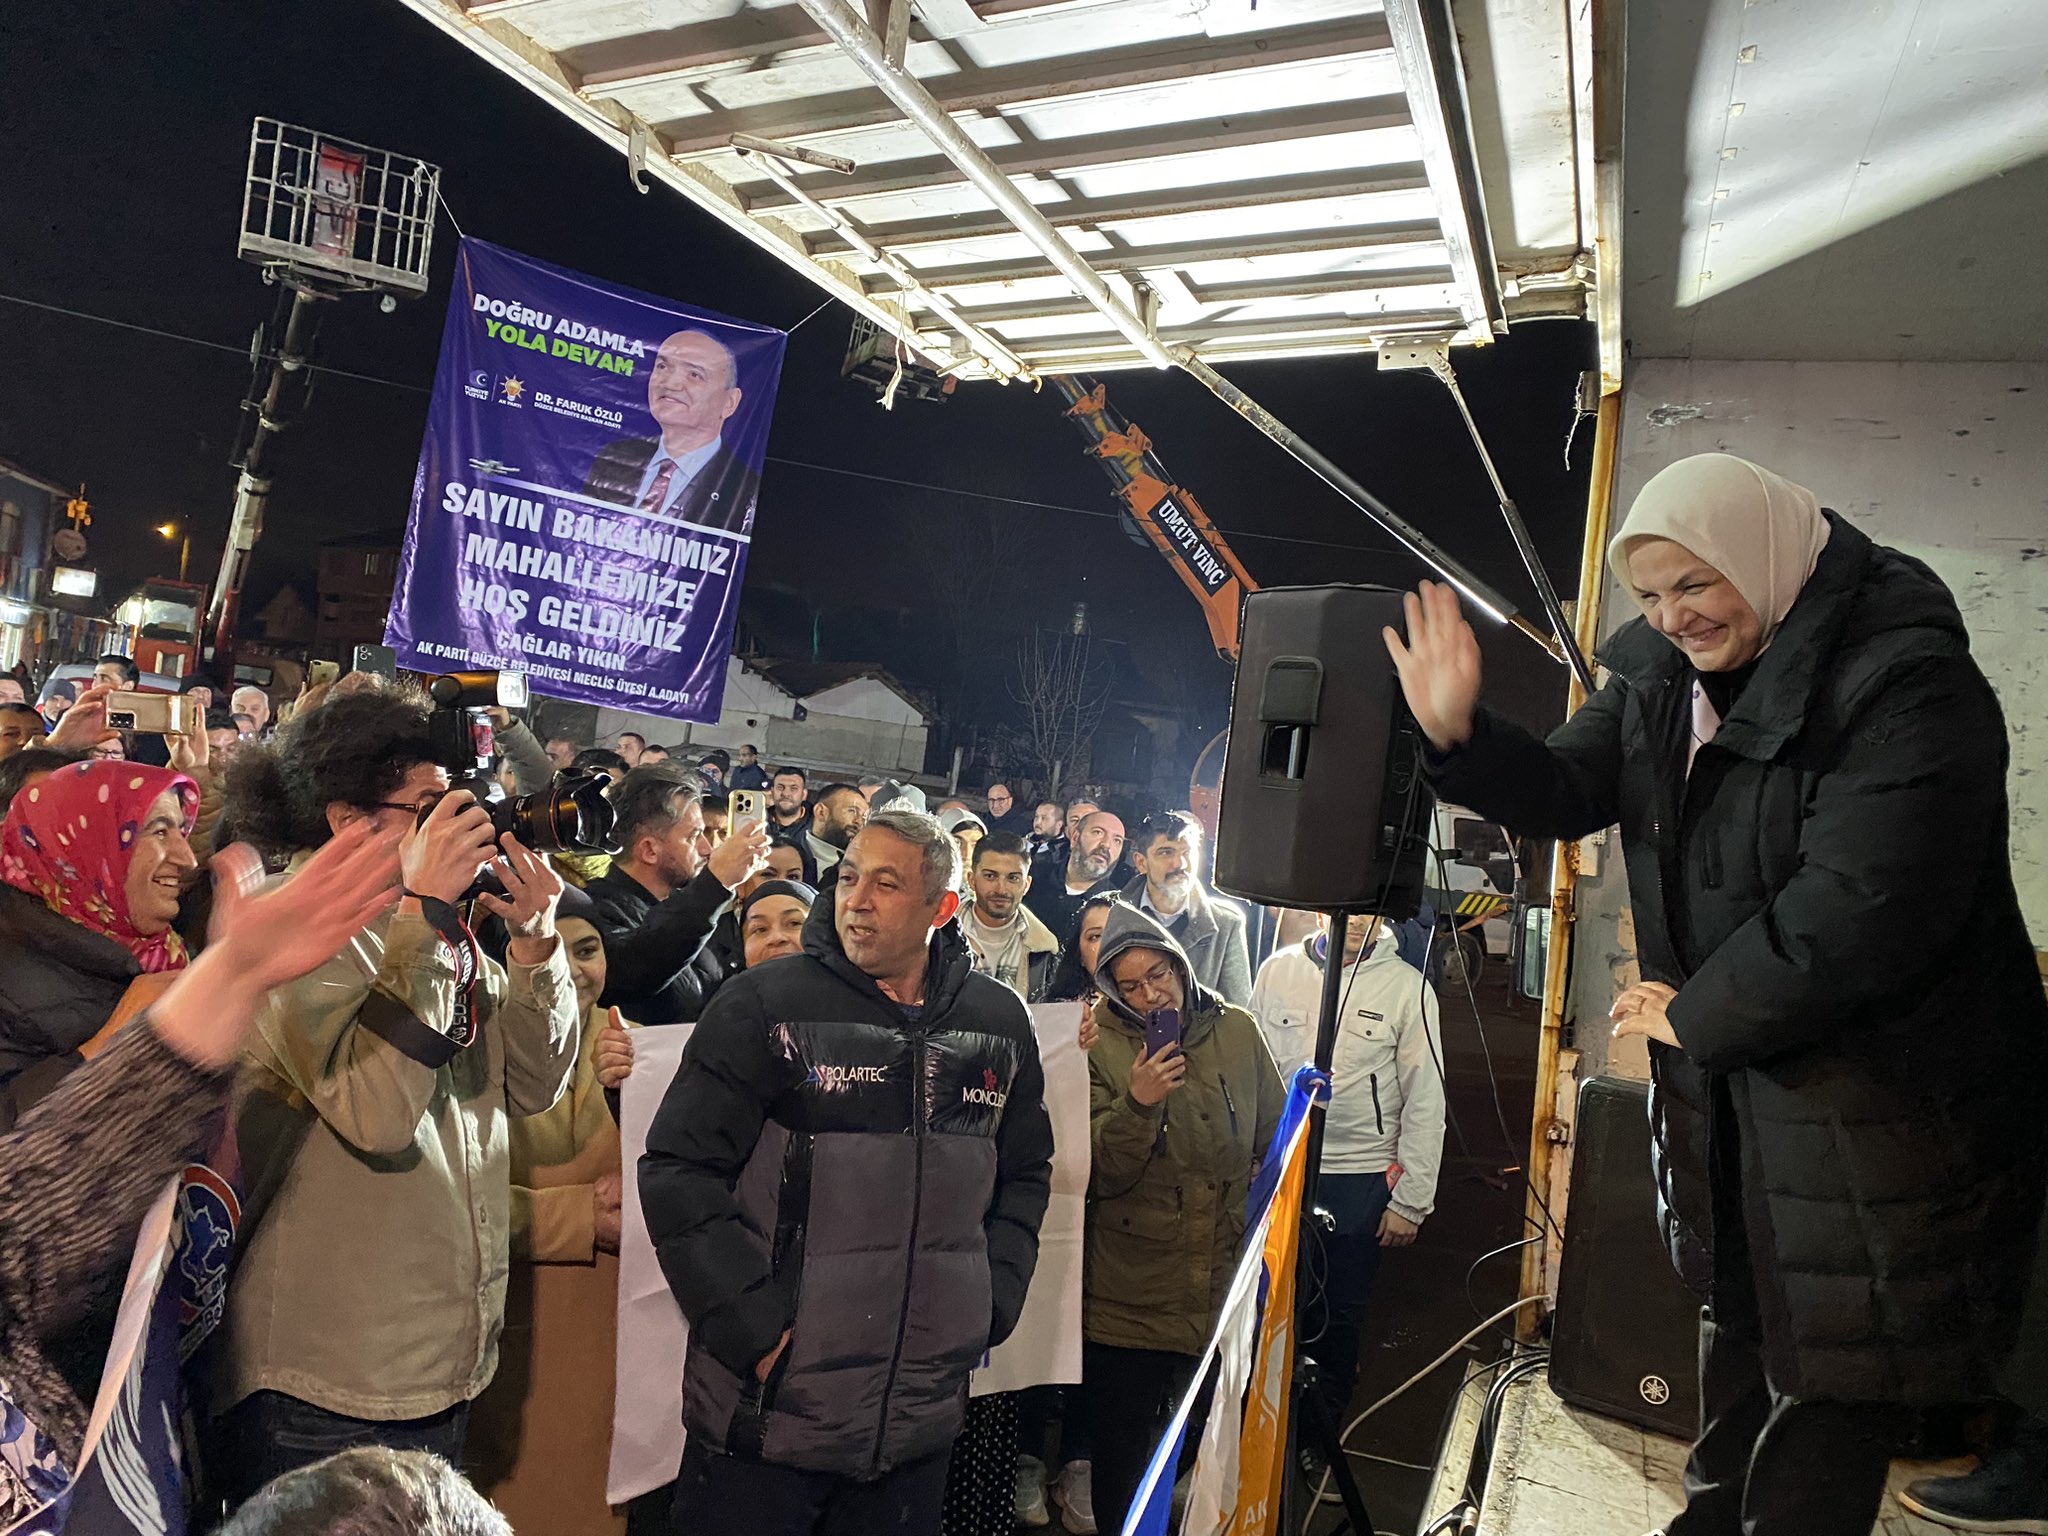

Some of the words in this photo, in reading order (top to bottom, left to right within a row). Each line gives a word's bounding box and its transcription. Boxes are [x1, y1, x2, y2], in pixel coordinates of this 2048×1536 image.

[474, 293, 552, 331] DOĞRU
[554, 318, 645, 358] ADAMLA
[485, 317, 547, 353] YOLA
[552, 338, 634, 377] DEVAM
[535, 391, 554, 405] DR.
[556, 397, 593, 416] FARUK
[594, 406, 623, 423] ÖZLÜ
[442, 481, 544, 533] SAYIN
[551, 508, 730, 576] BAKANIMIZ
[1159, 499, 1199, 550] UMUT
[464, 533, 699, 612] MAHALLEMİZE
[459, 578, 530, 623] HOŞ
[537, 595, 686, 653] GELDİNİZ
[416, 641, 434, 655] AK
[435, 645, 469, 662] PARTİ
[573, 672, 613, 691] MECLİS
[616, 678, 647, 697] ÜYESİ
[648, 686, 690, 705] A.ADAYI
[577, 645, 626, 672] YIKIN
